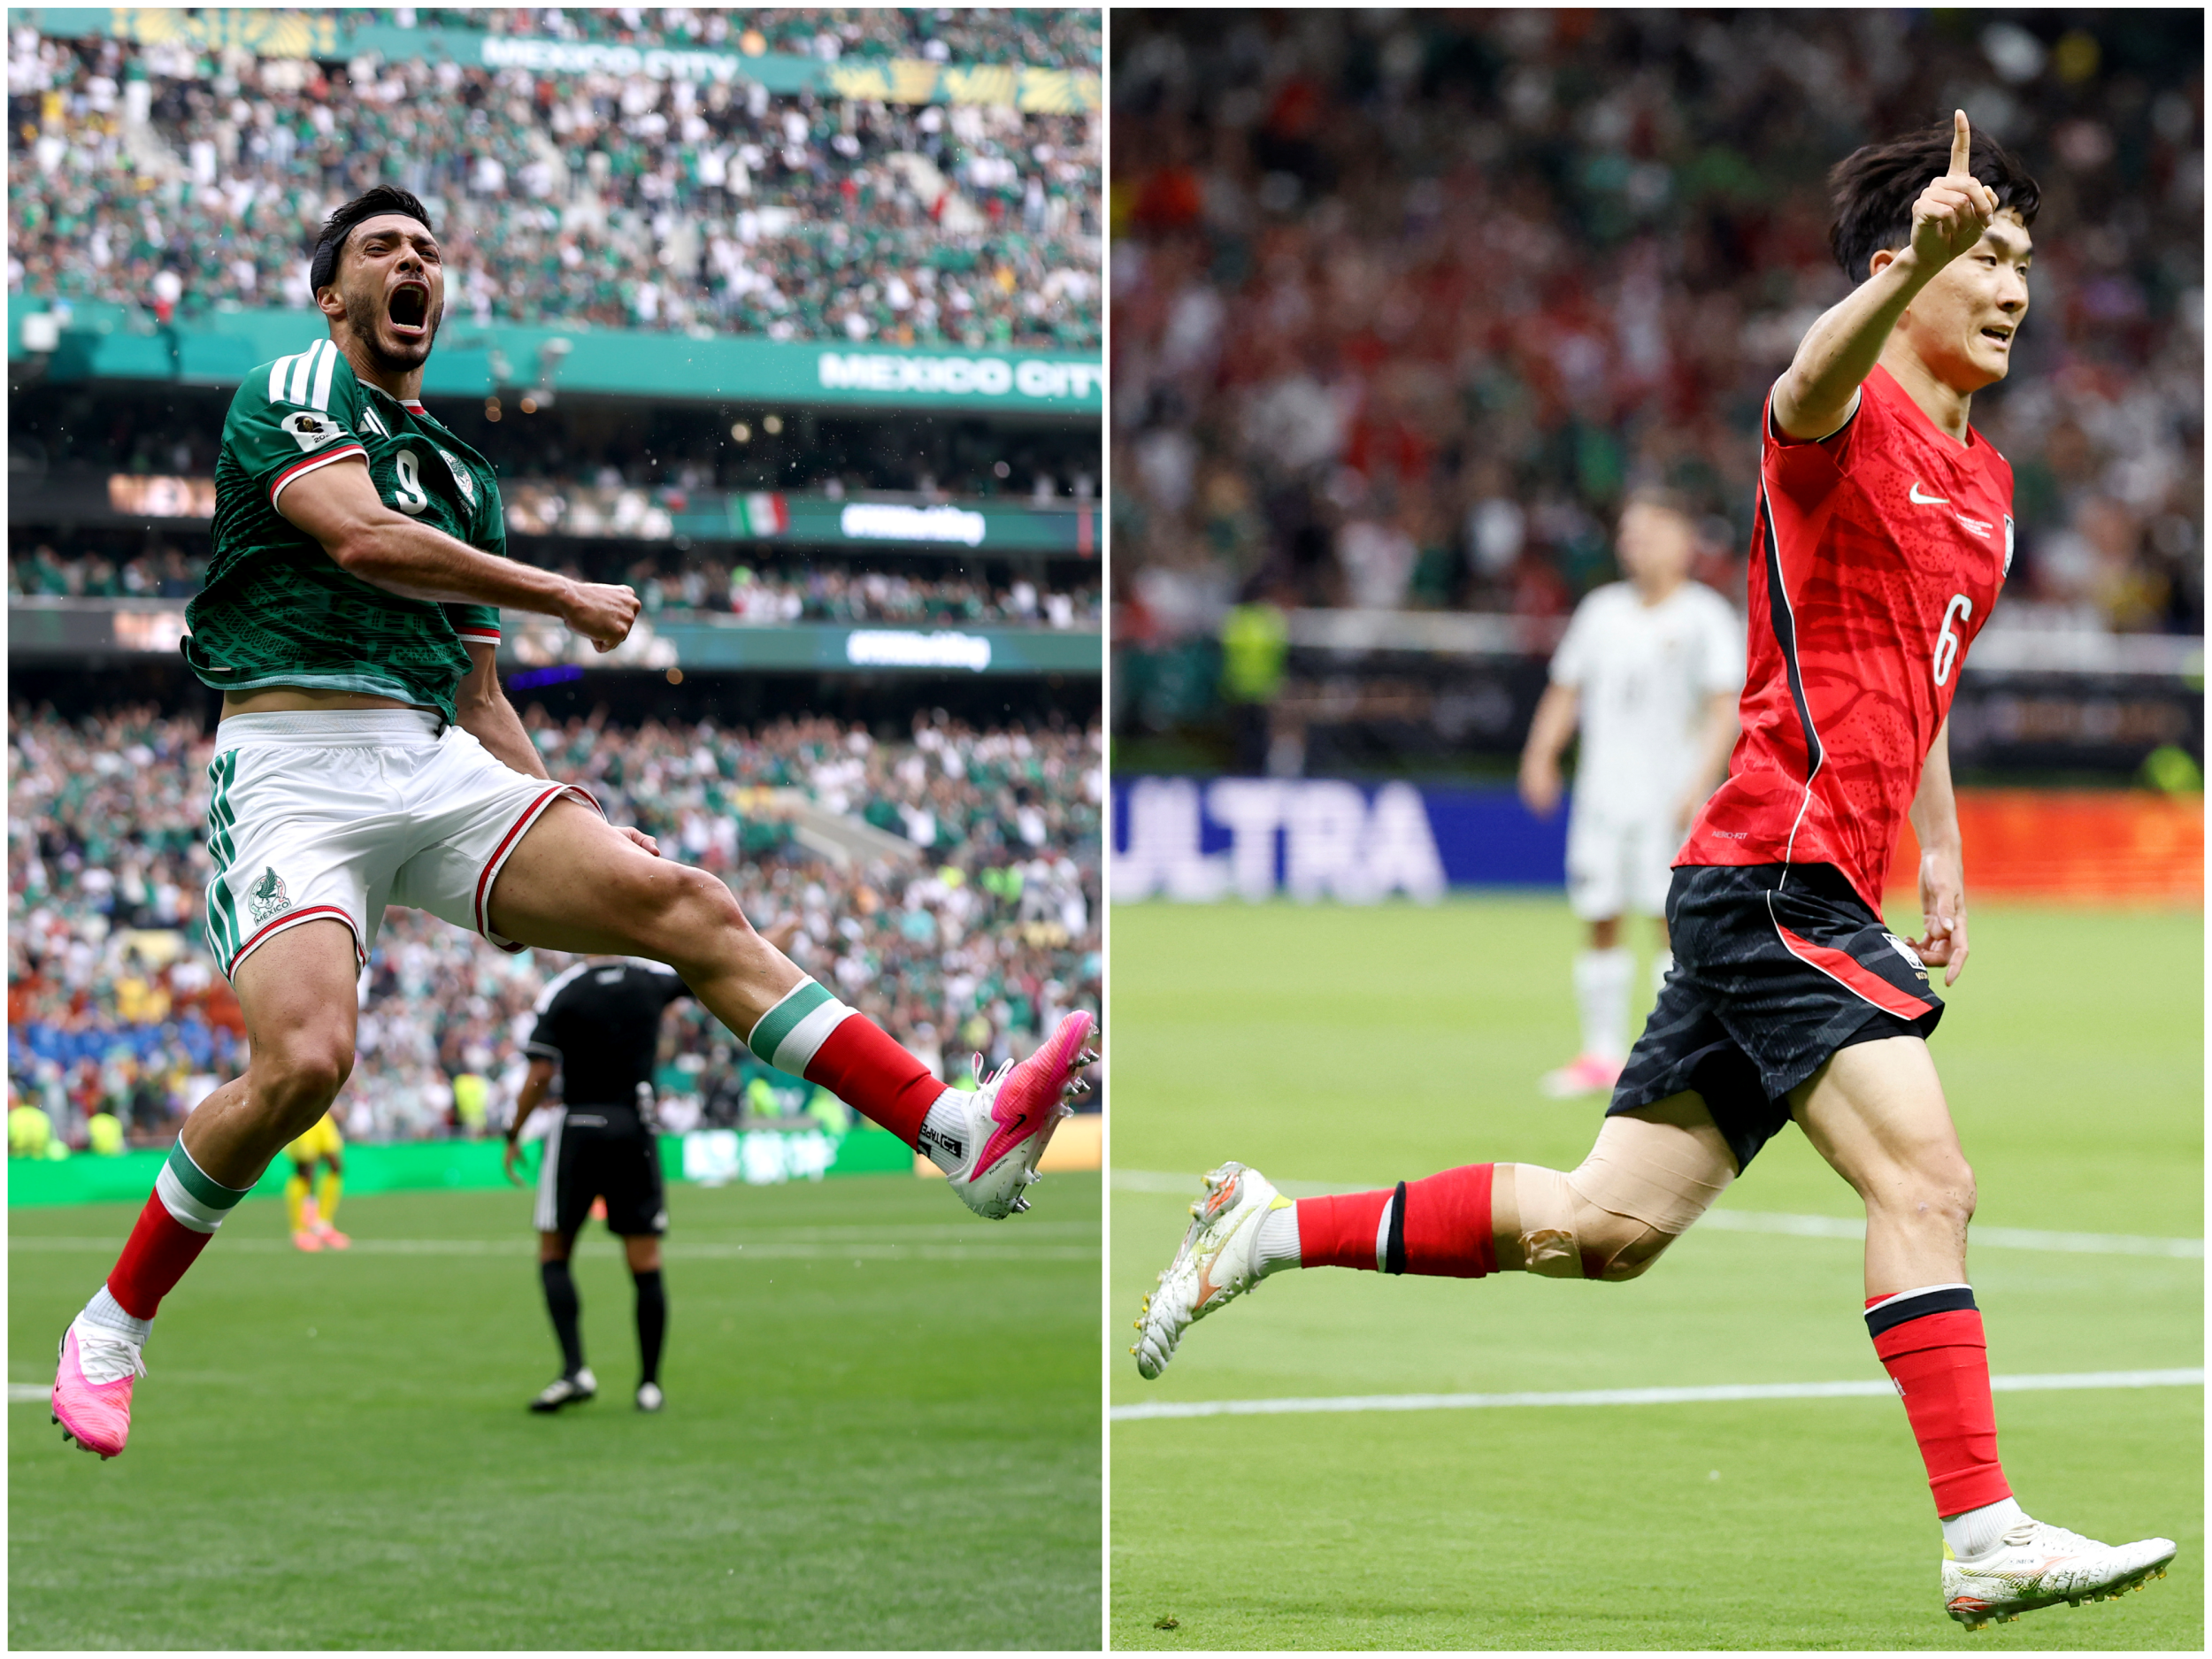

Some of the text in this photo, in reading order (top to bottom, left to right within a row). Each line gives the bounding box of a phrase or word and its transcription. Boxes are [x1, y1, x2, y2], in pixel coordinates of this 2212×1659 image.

[481, 36, 739, 81] MEXICO CITY
[818, 352, 1013, 395] MEXICO
[396, 449, 428, 515] 9
[1933, 593, 1973, 687] 6
